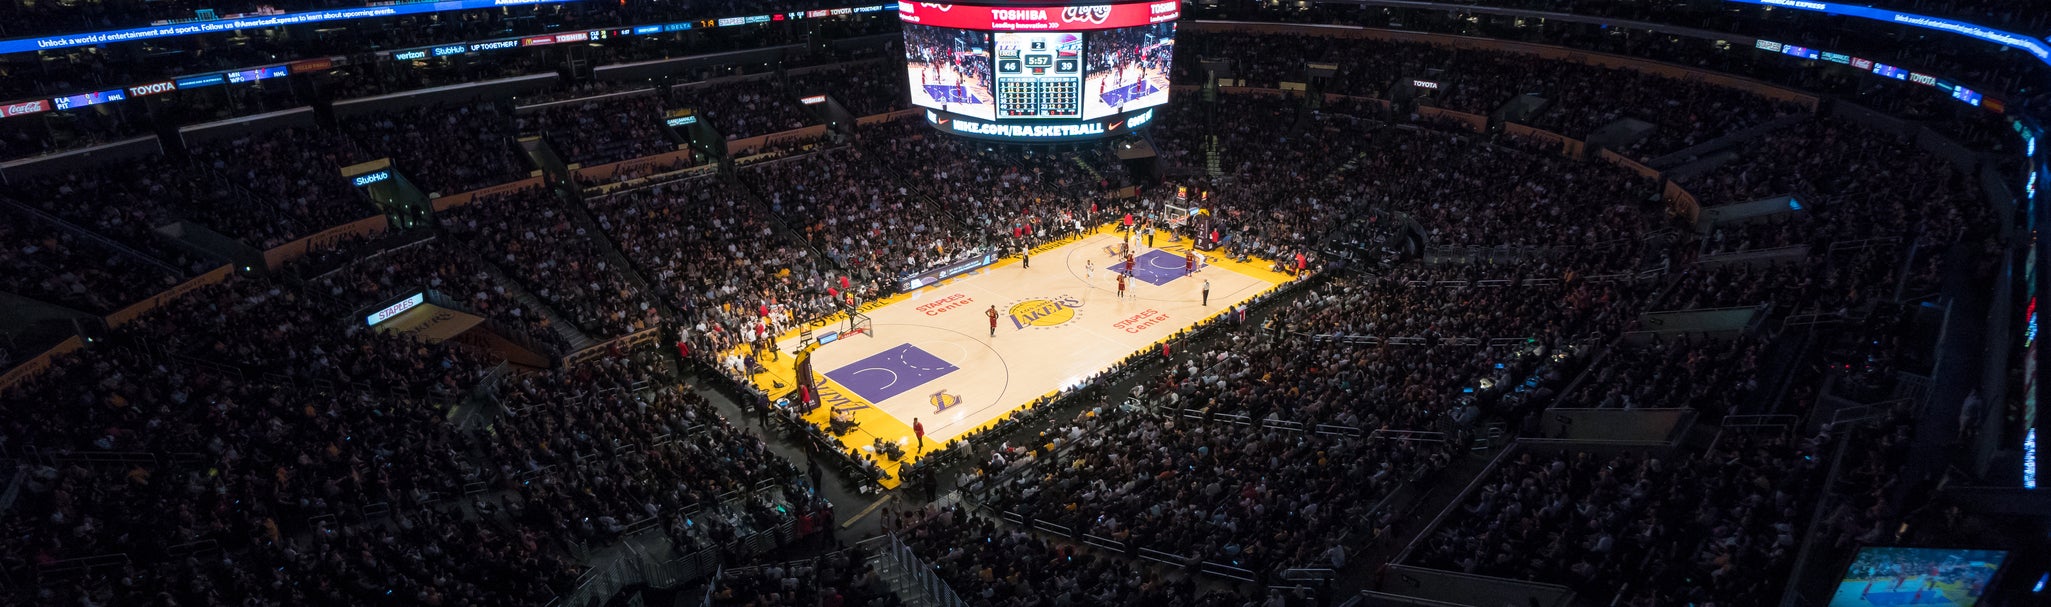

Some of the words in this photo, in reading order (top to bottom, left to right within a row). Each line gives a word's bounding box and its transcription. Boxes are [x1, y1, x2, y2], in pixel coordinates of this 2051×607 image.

[991, 9, 1048, 21] TOSHIBA
[37, 37, 68, 48] Unlock
[75, 35, 98, 44] world
[99, 34, 107, 42] of
[107, 29, 158, 41] entertainment
[159, 27, 174, 36] and
[175, 26, 201, 35] sports.
[201, 23, 224, 31] Follow
[306, 13, 323, 21] learn
[324, 11, 342, 20] about
[343, 10, 374, 19] upcoming
[991, 22, 1015, 30] Leading
[556, 33, 588, 42] TOSHIBA
[434, 45, 465, 55] StubHub
[481, 41, 513, 50] TOGETHER
[396, 51, 425, 60] verizon
[1028, 57, 1048, 65] 5:57
[1061, 62, 1073, 70] 39
[1413, 80, 1438, 89] TOYOTA
[1909, 72, 1936, 87] TOYOTA
[129, 82, 175, 97] TOYOTA
[8, 101, 42, 115] Coca-Cola
[953, 119, 1104, 137] NIKE.COM/BASKETBALL
[356, 171, 388, 186] StubHub
[378, 299, 414, 320] STAPLES
[916, 293, 966, 312] STAPLES
[926, 297, 974, 317] Center
[1010, 298, 1080, 331] LAKERS
[1113, 308, 1159, 329] STAPLES
[1125, 313, 1170, 334] Center
